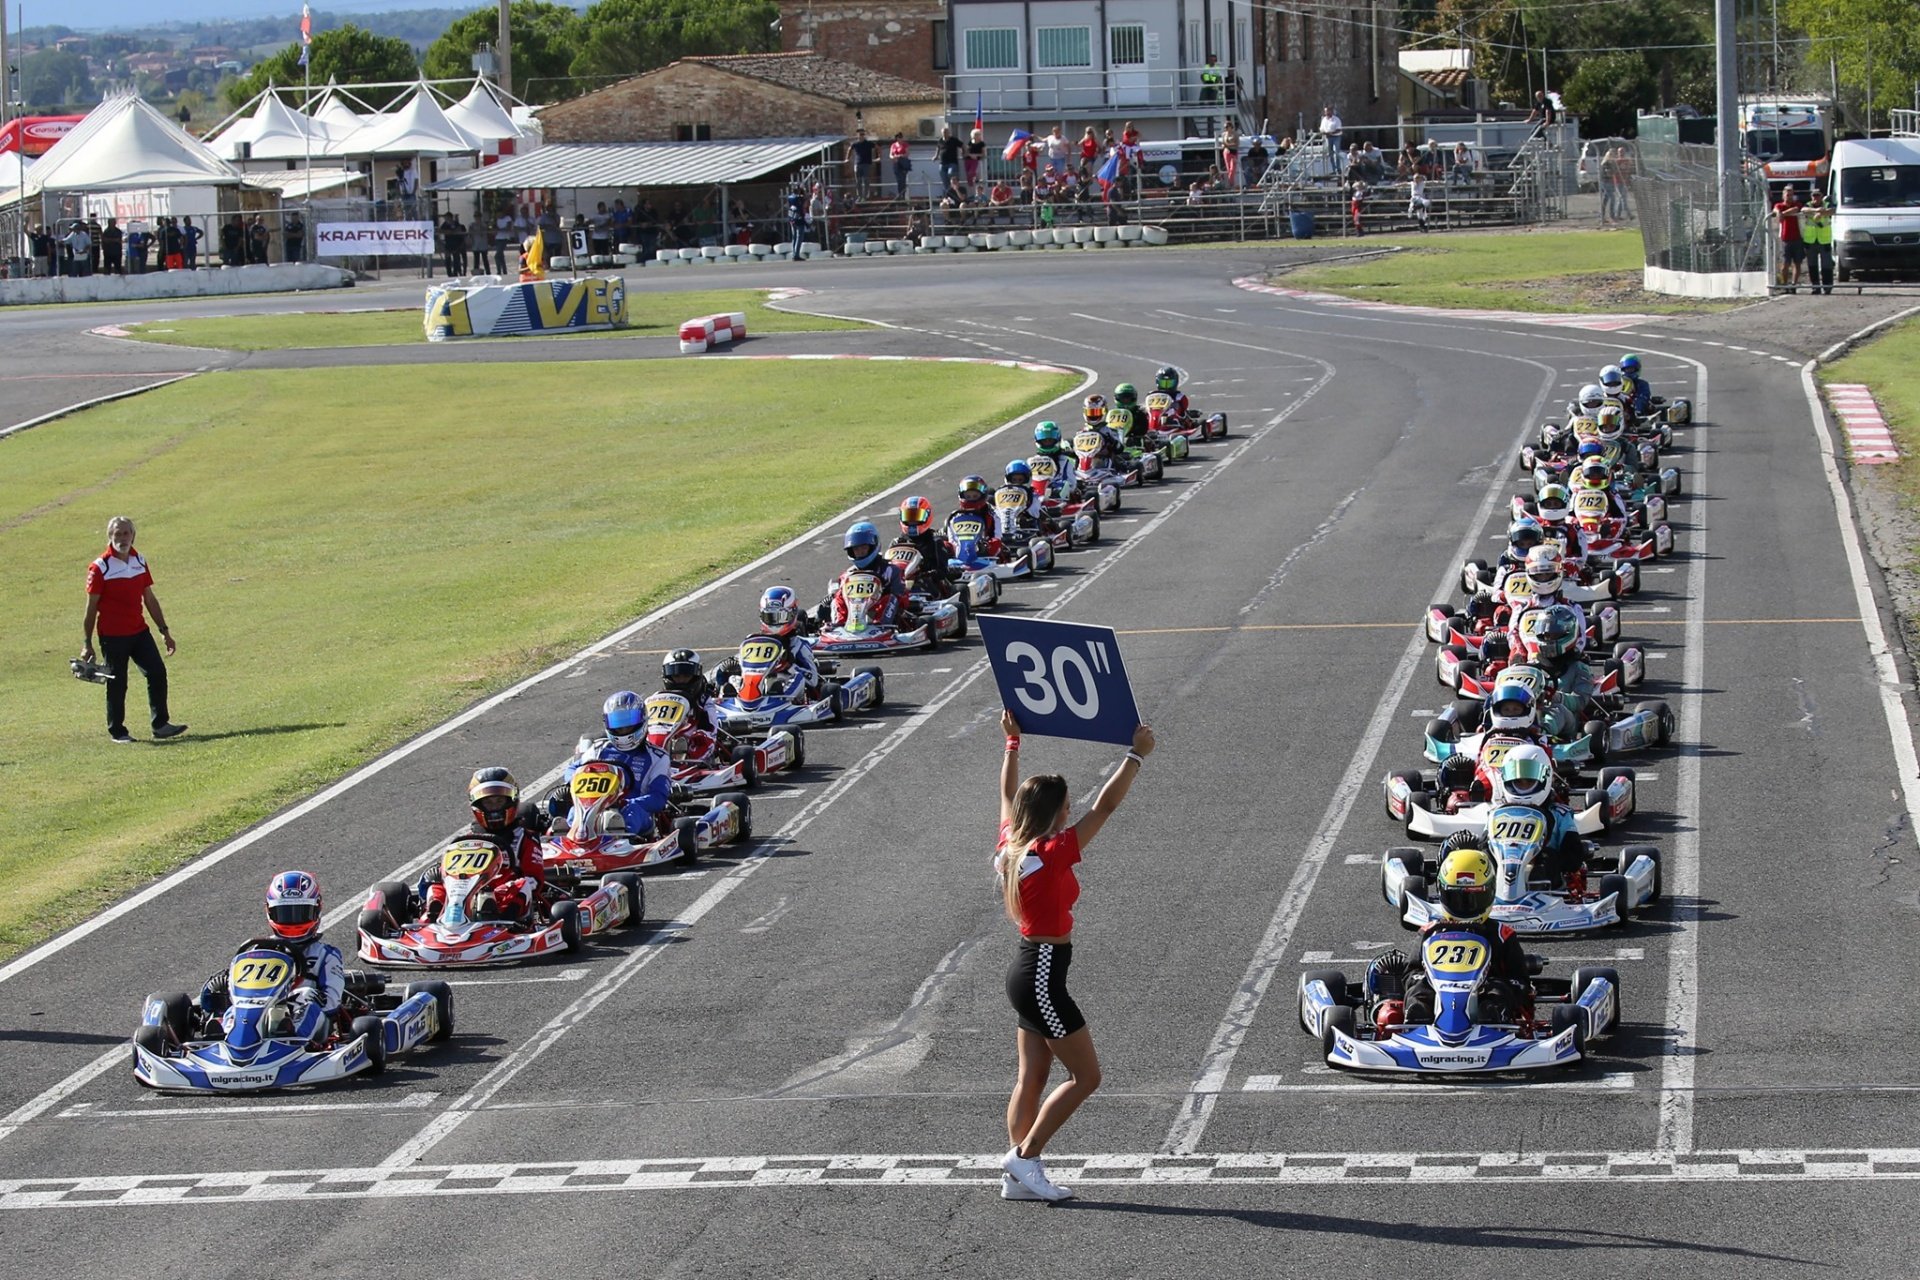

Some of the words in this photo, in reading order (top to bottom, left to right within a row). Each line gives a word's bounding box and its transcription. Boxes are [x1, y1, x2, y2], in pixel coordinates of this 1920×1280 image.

[34, 125, 74, 134] easykar
[319, 229, 430, 242] KRAFTWERK
[571, 233, 583, 250] 6
[1031, 461, 1051, 472] 222
[1001, 494, 1021, 503] 228
[1578, 496, 1602, 508] 262
[955, 523, 979, 534] 229
[890, 549, 914, 560] 230
[846, 583, 875, 596] 263
[1511, 581, 1532, 593] 21
[743, 646, 774, 660] 218
[1005, 640, 1111, 721] 30"
[648, 704, 678, 721] 281
[575, 777, 612, 794] 250
[1494, 821, 1536, 840] 209
[447, 853, 489, 871] 270
[1431, 945, 1479, 966] 231
[237, 964, 285, 983] 214
[1337, 1036, 1355, 1055] MLG
[1555, 1032, 1572, 1053] MLG
[343, 1040, 363, 1065] MLG
